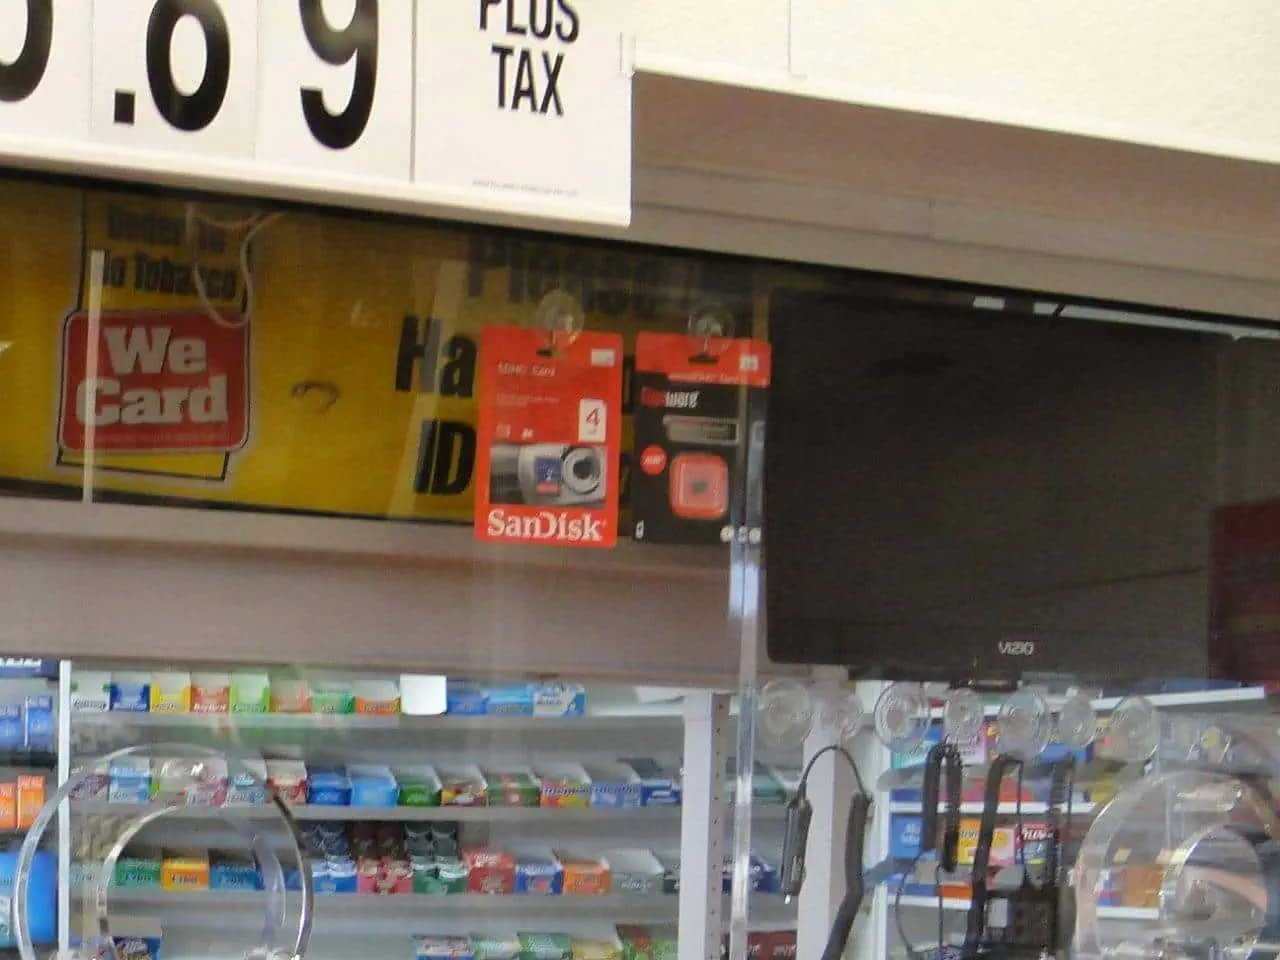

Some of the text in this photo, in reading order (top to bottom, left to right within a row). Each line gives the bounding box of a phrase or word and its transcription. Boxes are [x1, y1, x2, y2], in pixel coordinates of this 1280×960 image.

[492, 44, 565, 117] TAX
[103, 327, 206, 375] We
[76, 374, 229, 428] Card
[414, 420, 477, 496] ID
[486, 507, 608, 542] SanDisk
